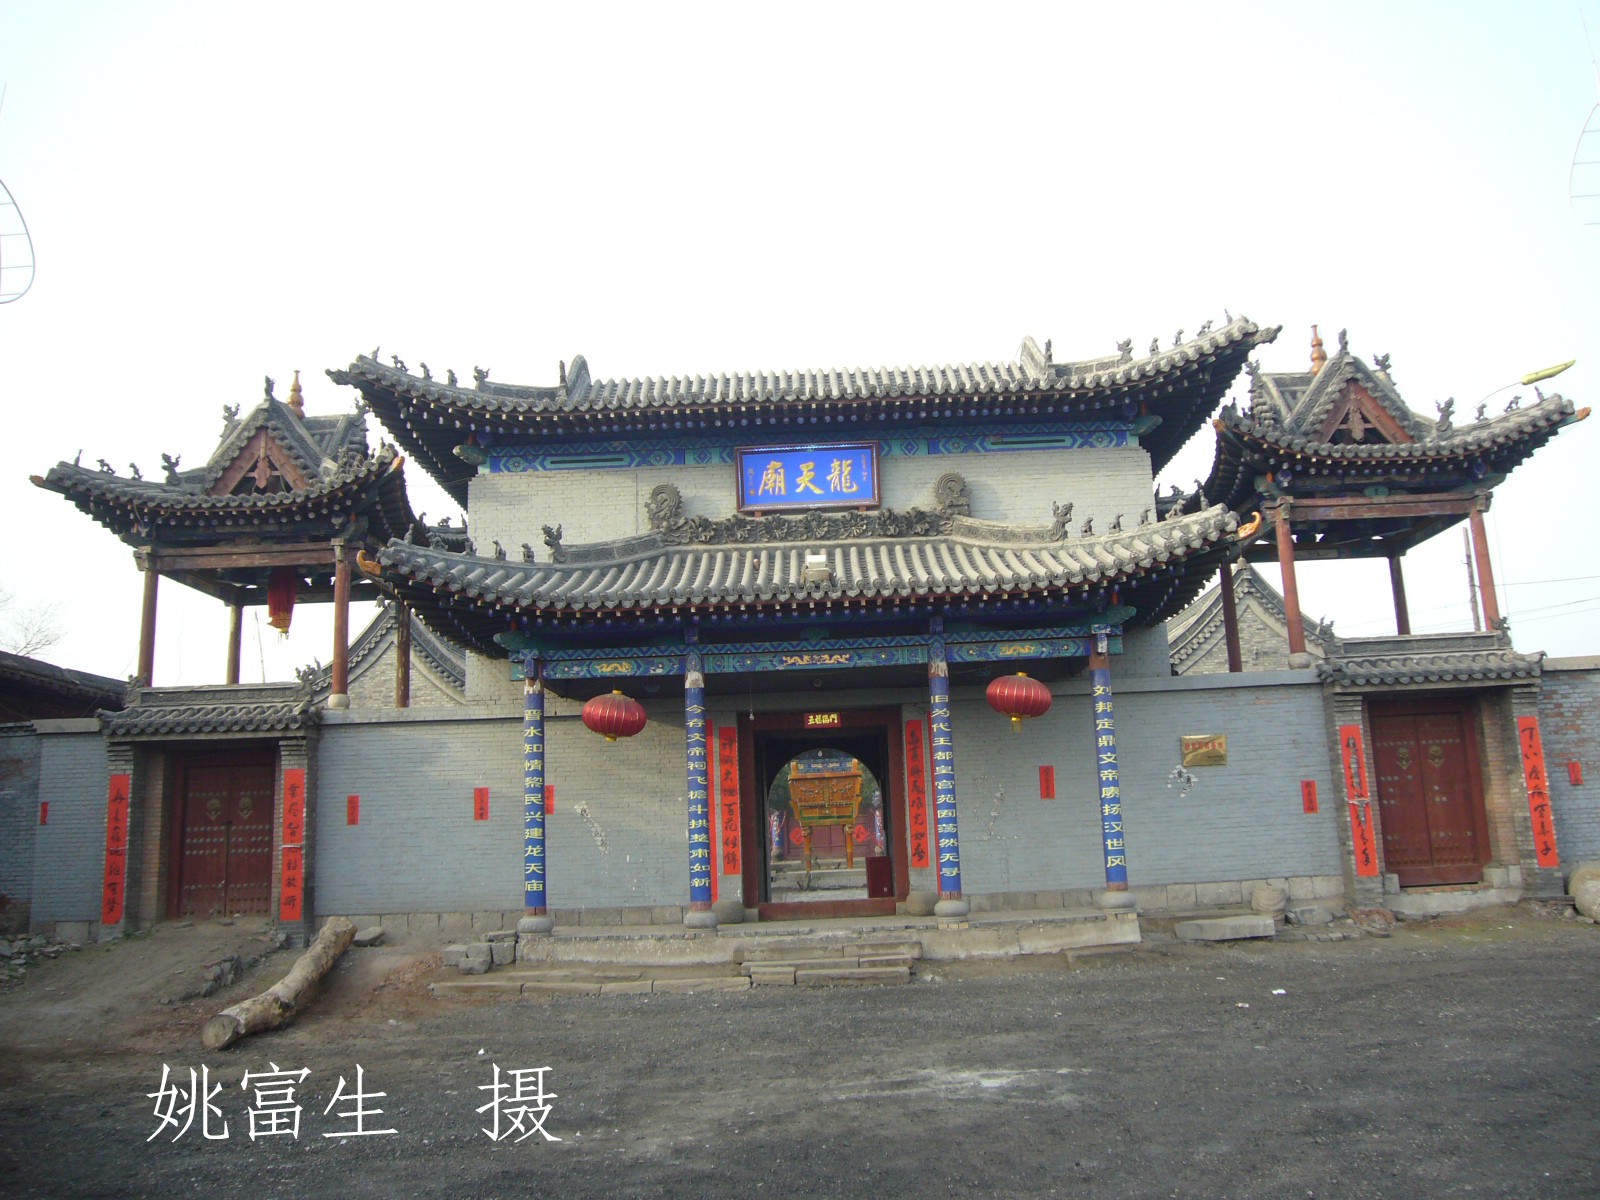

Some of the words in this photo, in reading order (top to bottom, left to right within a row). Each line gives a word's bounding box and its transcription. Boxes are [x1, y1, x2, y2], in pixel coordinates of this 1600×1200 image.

[524, 709, 544, 892] 晋水知情黎民兴建龙天庙
[686, 704, 710, 888] 今存文帝祠飞檐斗拱整肃如新
